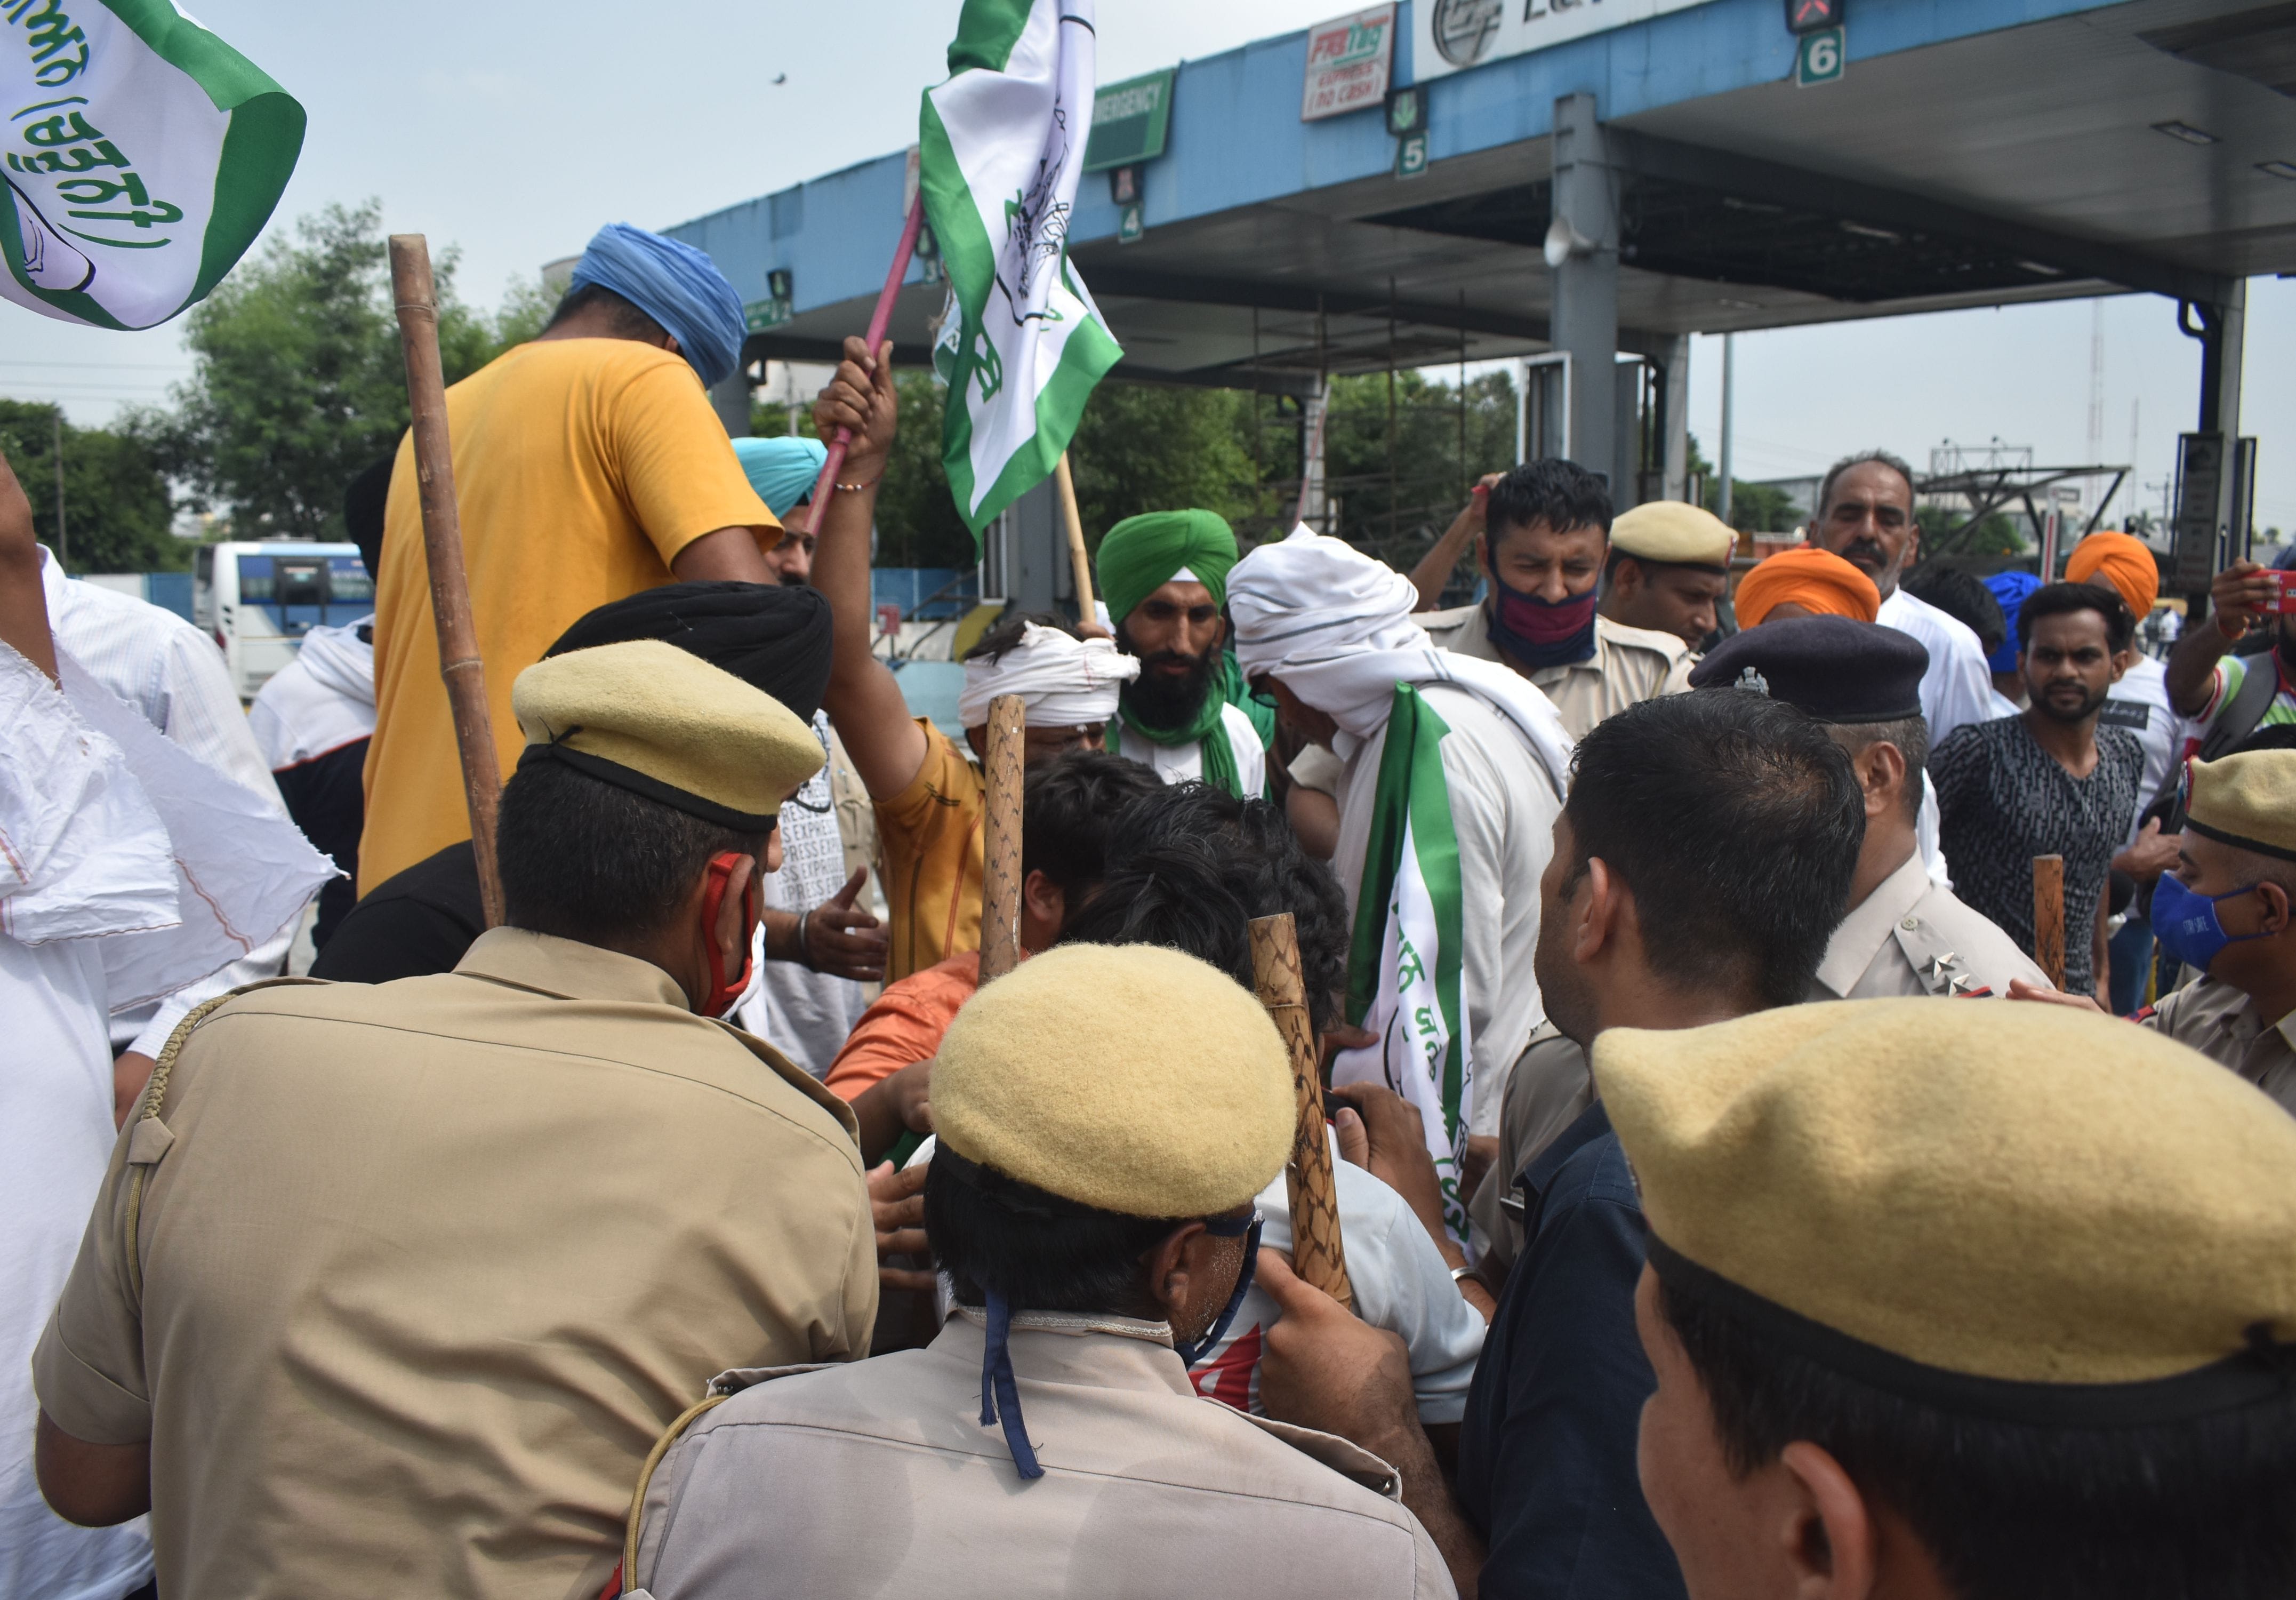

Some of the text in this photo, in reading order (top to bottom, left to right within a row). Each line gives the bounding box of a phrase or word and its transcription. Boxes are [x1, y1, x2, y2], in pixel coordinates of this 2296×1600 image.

[1808, 36, 1838, 76] 6
[1092, 82, 1162, 124] MERGENCY
[1403, 137, 1425, 170] 5
[1123, 209, 1139, 231] 4
[926, 259, 937, 282] 3
